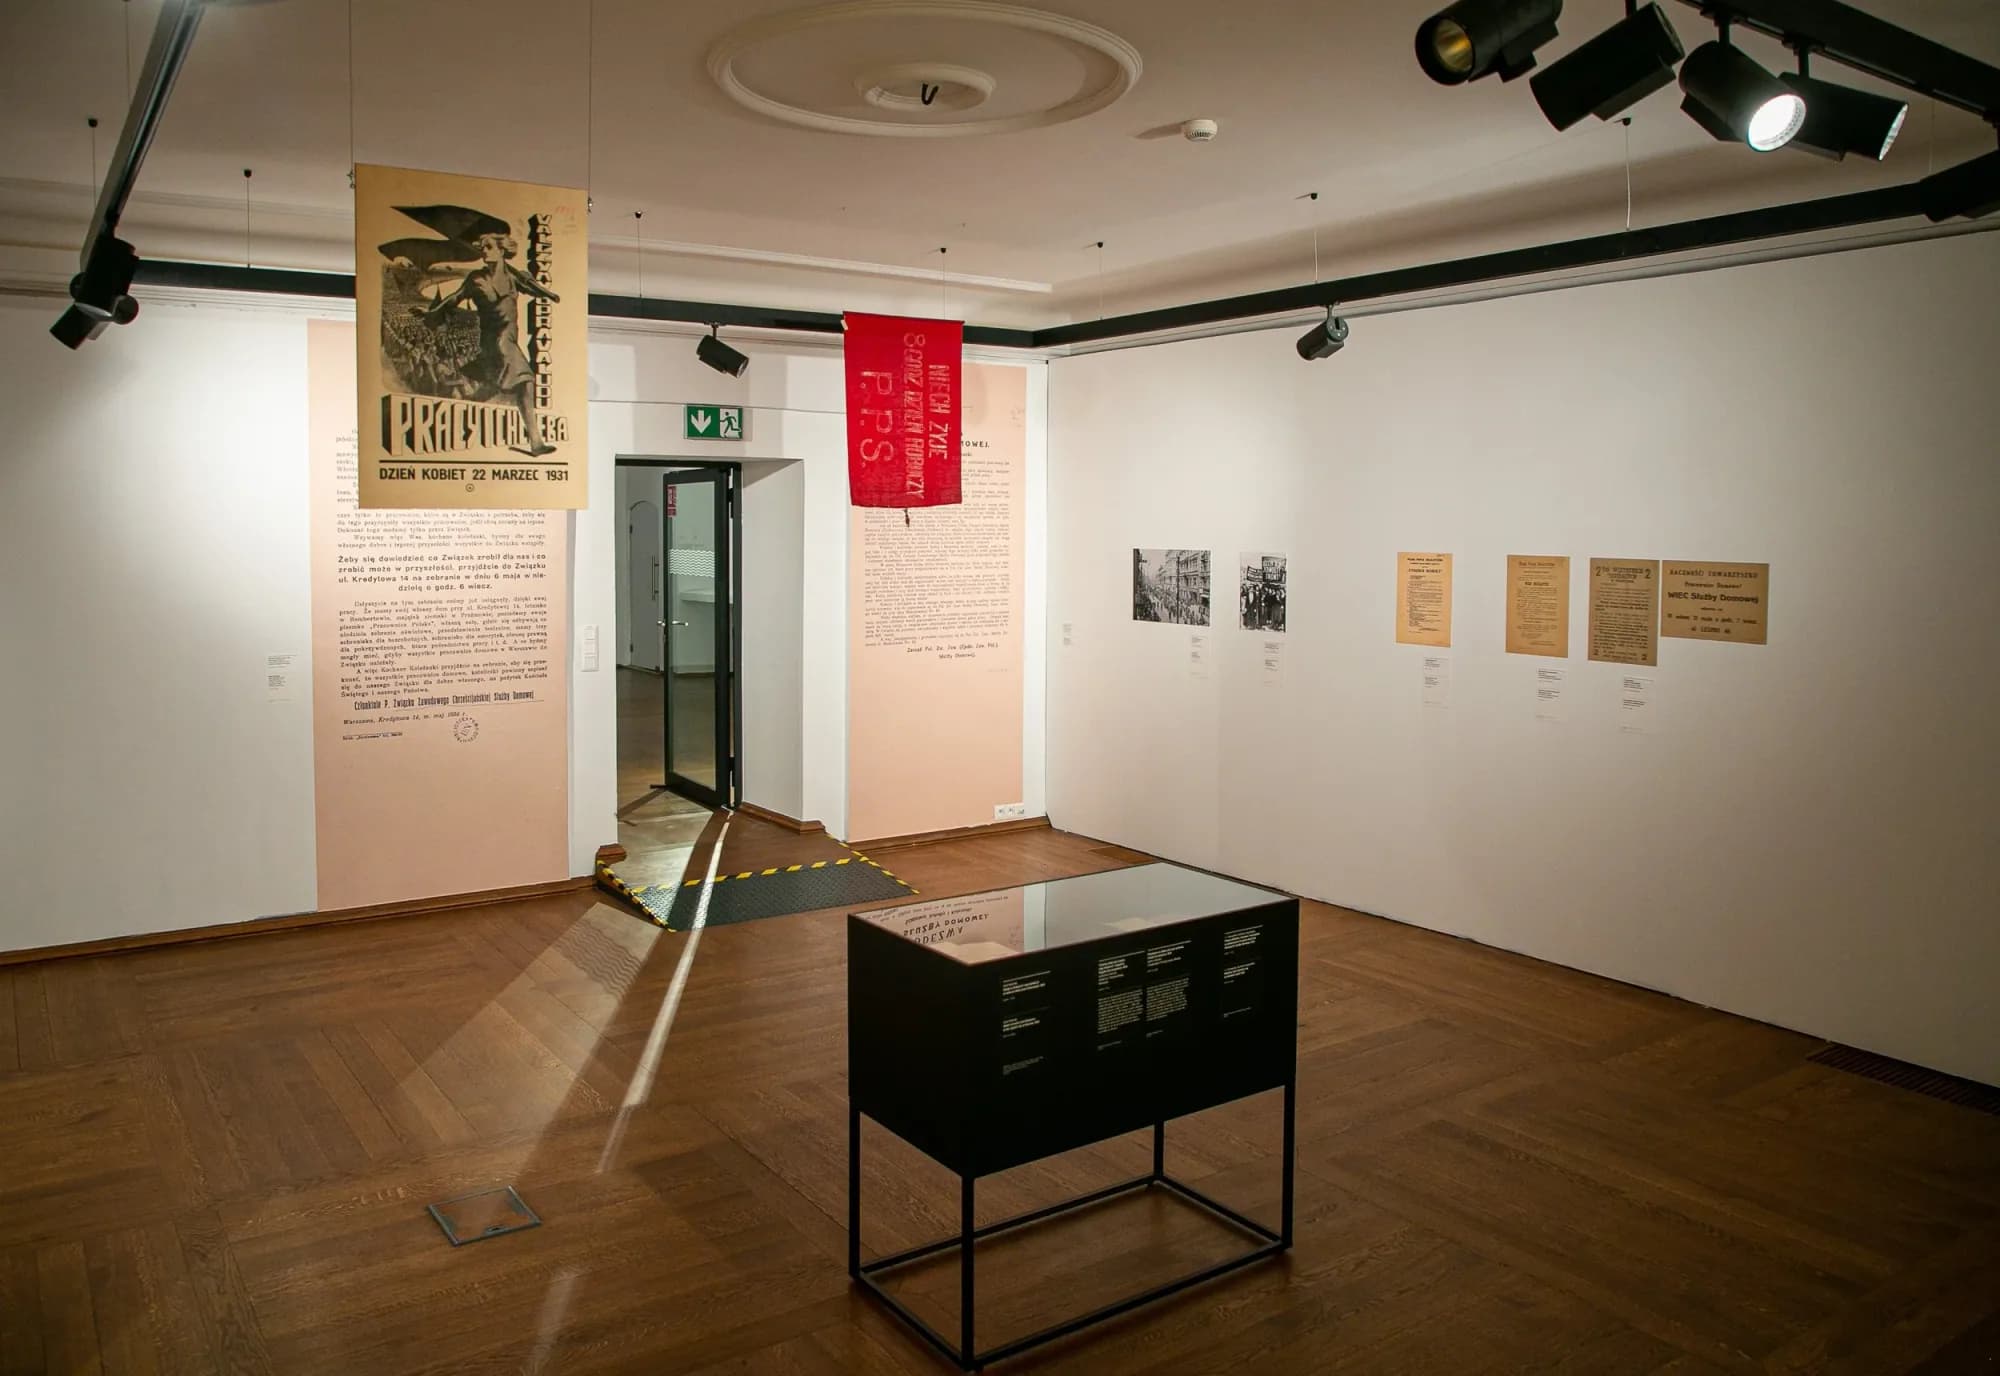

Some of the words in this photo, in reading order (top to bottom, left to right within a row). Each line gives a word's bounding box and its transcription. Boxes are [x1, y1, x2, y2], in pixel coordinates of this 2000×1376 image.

[903, 333, 926, 348] 8
[928, 364, 951, 414] NIECH
[383, 394, 479, 456] PRACY
[481, 405, 494, 449] I
[928, 421, 952, 460] ŻYJE
[379, 465, 416, 480] DZIEŃ
[422, 468, 466, 480] KOBIET
[472, 469, 486, 480] 22
[492, 470, 540, 481] MARZEC
[546, 470, 569, 481] 1931
[338, 555, 358, 563] Żeby
[352, 575, 397, 584] Kredytowa
[1644, 568, 1652, 580] 2
[1668, 592, 1689, 600] WIEC
